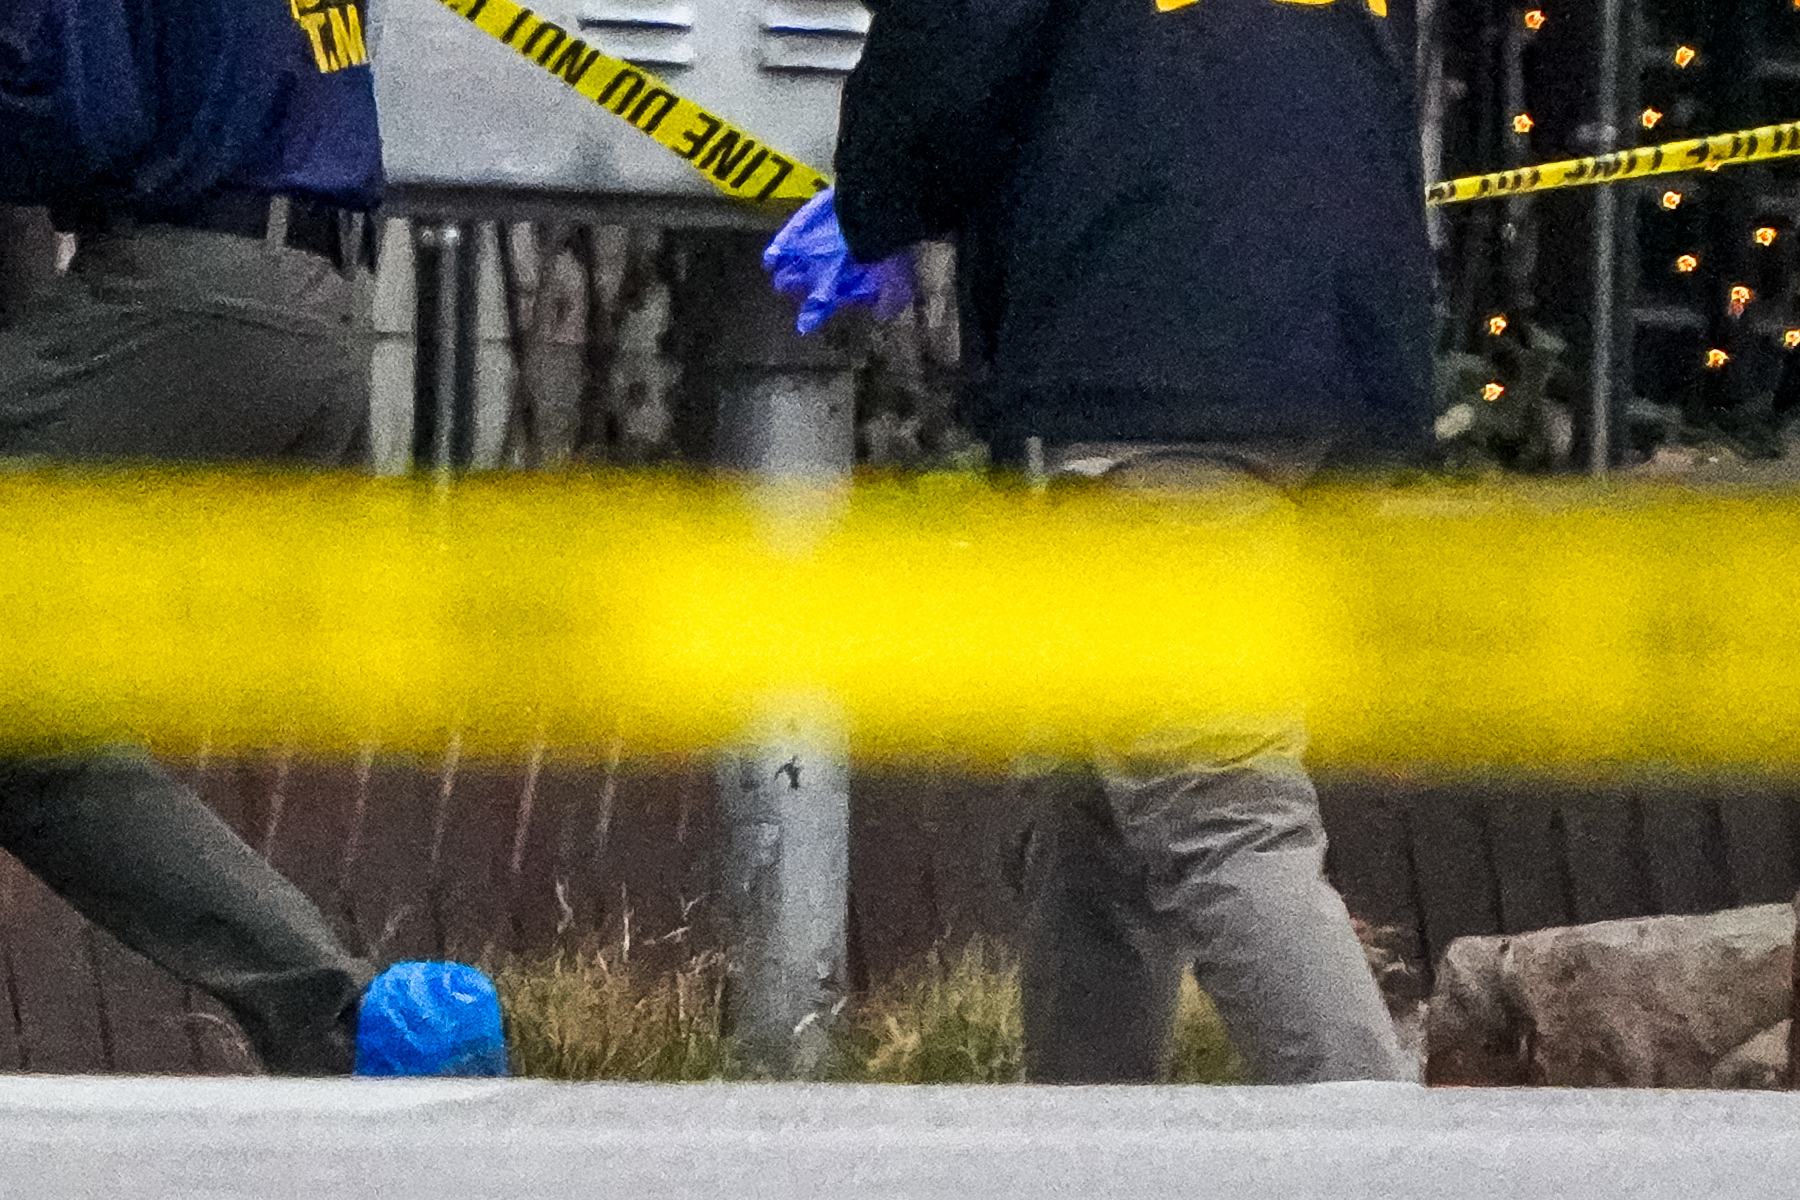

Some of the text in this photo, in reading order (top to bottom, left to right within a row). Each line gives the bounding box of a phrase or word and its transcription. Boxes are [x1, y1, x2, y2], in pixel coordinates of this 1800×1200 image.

[502, 5, 602, 86] NOT
[596, 67, 679, 137] DO
[672, 110, 796, 202] LINE
